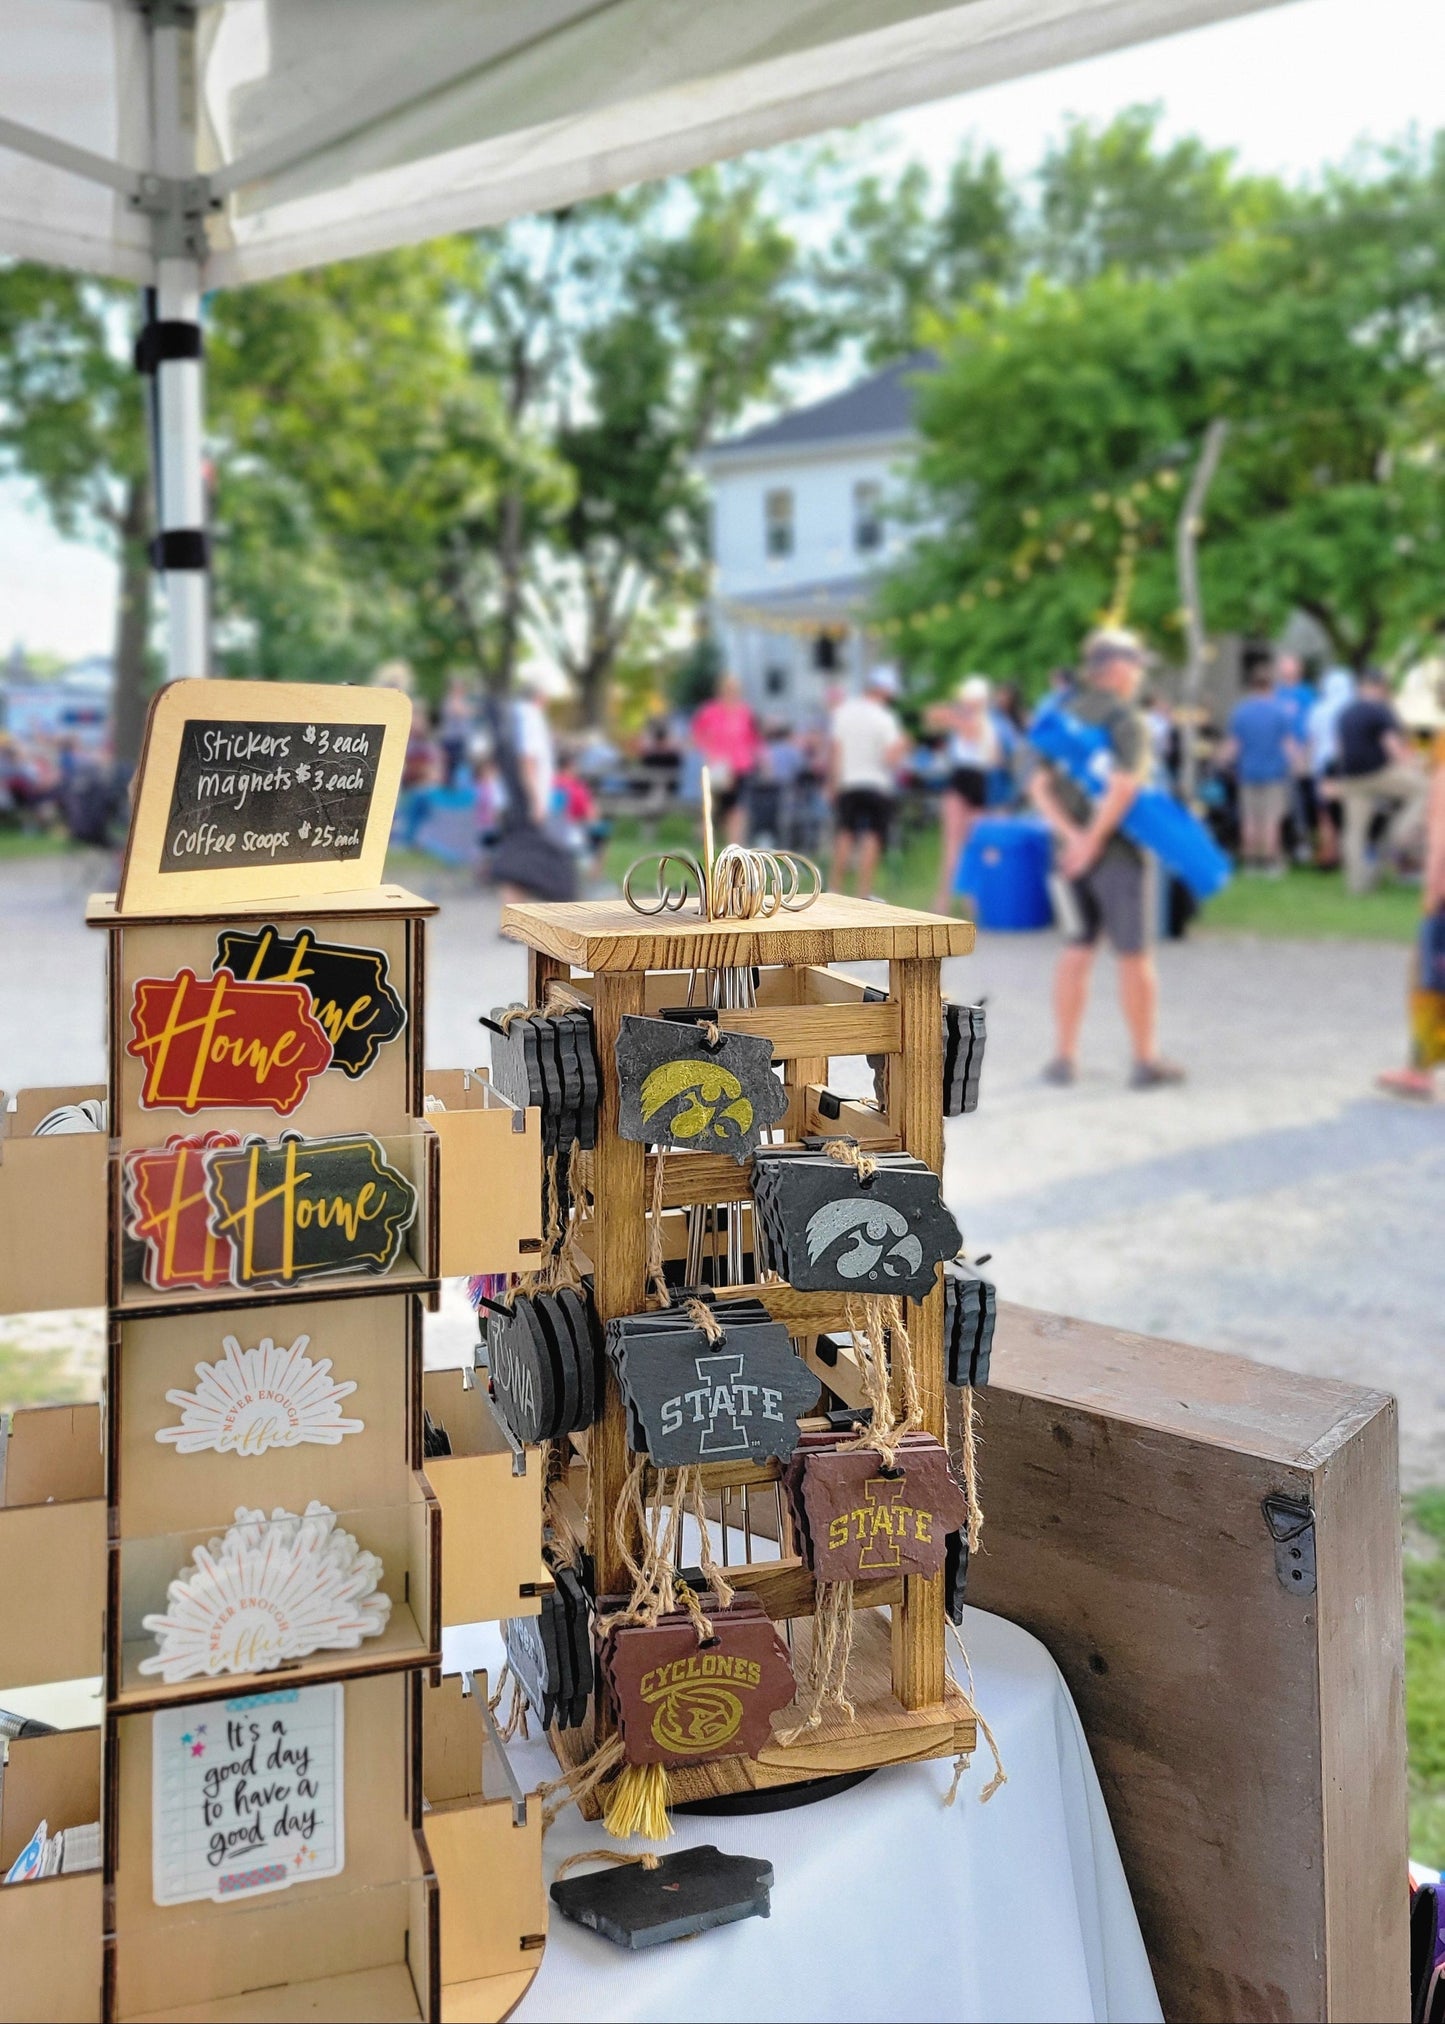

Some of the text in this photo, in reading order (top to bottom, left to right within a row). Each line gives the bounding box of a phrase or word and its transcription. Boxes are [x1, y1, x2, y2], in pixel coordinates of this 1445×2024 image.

[202, 731, 291, 763] Stickers
[333, 733, 369, 756] each
[326, 768, 364, 791] each
[173, 823, 235, 857] Coffee
[242, 830, 290, 857] scoops
[134, 975, 306, 1108] Home
[219, 1139, 387, 1280] Home
[222, 1390, 299, 1432] NEVER ENOUGH
[660, 1384, 784, 1436] STATE
[220, 1416, 301, 1451] coffee
[828, 1505, 932, 1550] STATE
[209, 1597, 289, 1651] NEVER ENOUGH
[640, 1654, 761, 1696] CYCLONES
[226, 1715, 287, 1750] It's a
[203, 1737, 312, 1798] good day
[203, 1778, 319, 1827] to have a
[207, 1804, 323, 1866] good day
